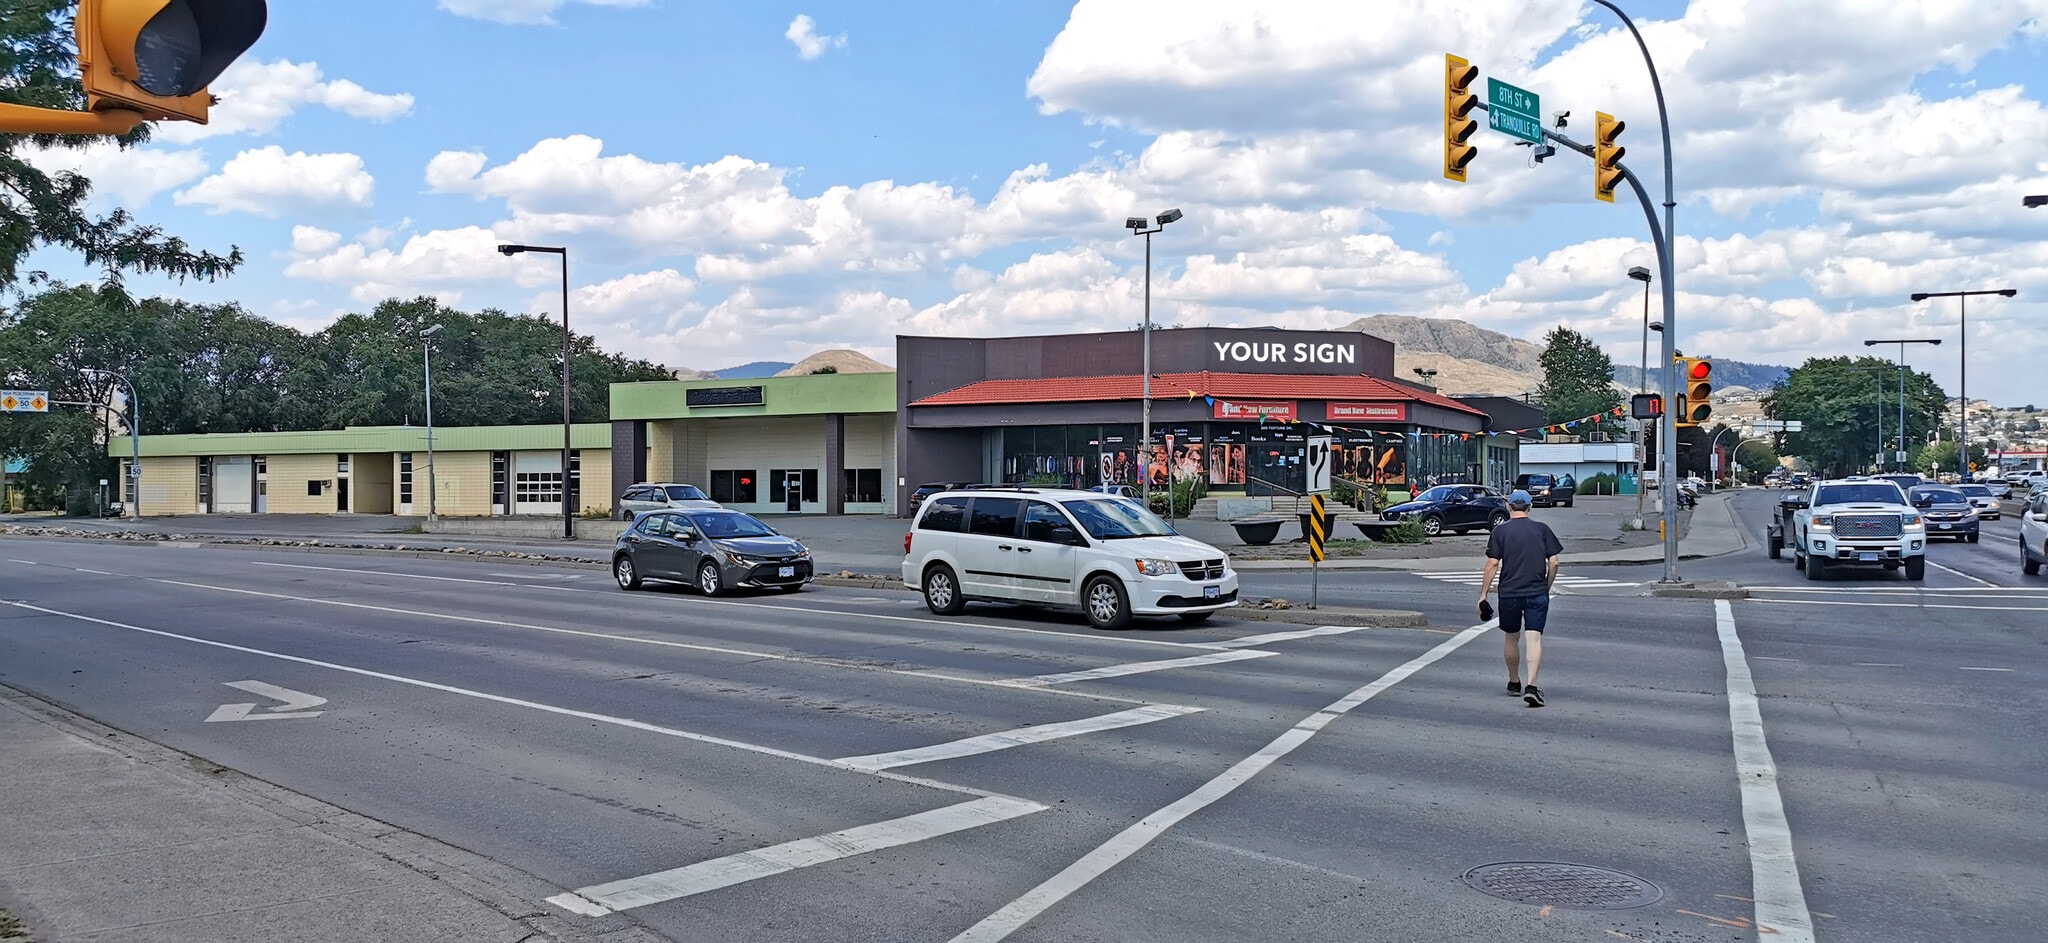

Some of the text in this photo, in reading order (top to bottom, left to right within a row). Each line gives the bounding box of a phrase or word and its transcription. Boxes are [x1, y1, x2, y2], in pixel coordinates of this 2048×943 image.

[1499, 86, 1523, 108] 8TH ST
[1500, 112, 1539, 139] TRANQUILLE RD
[1214, 342, 1355, 364] YOUR SIGN
